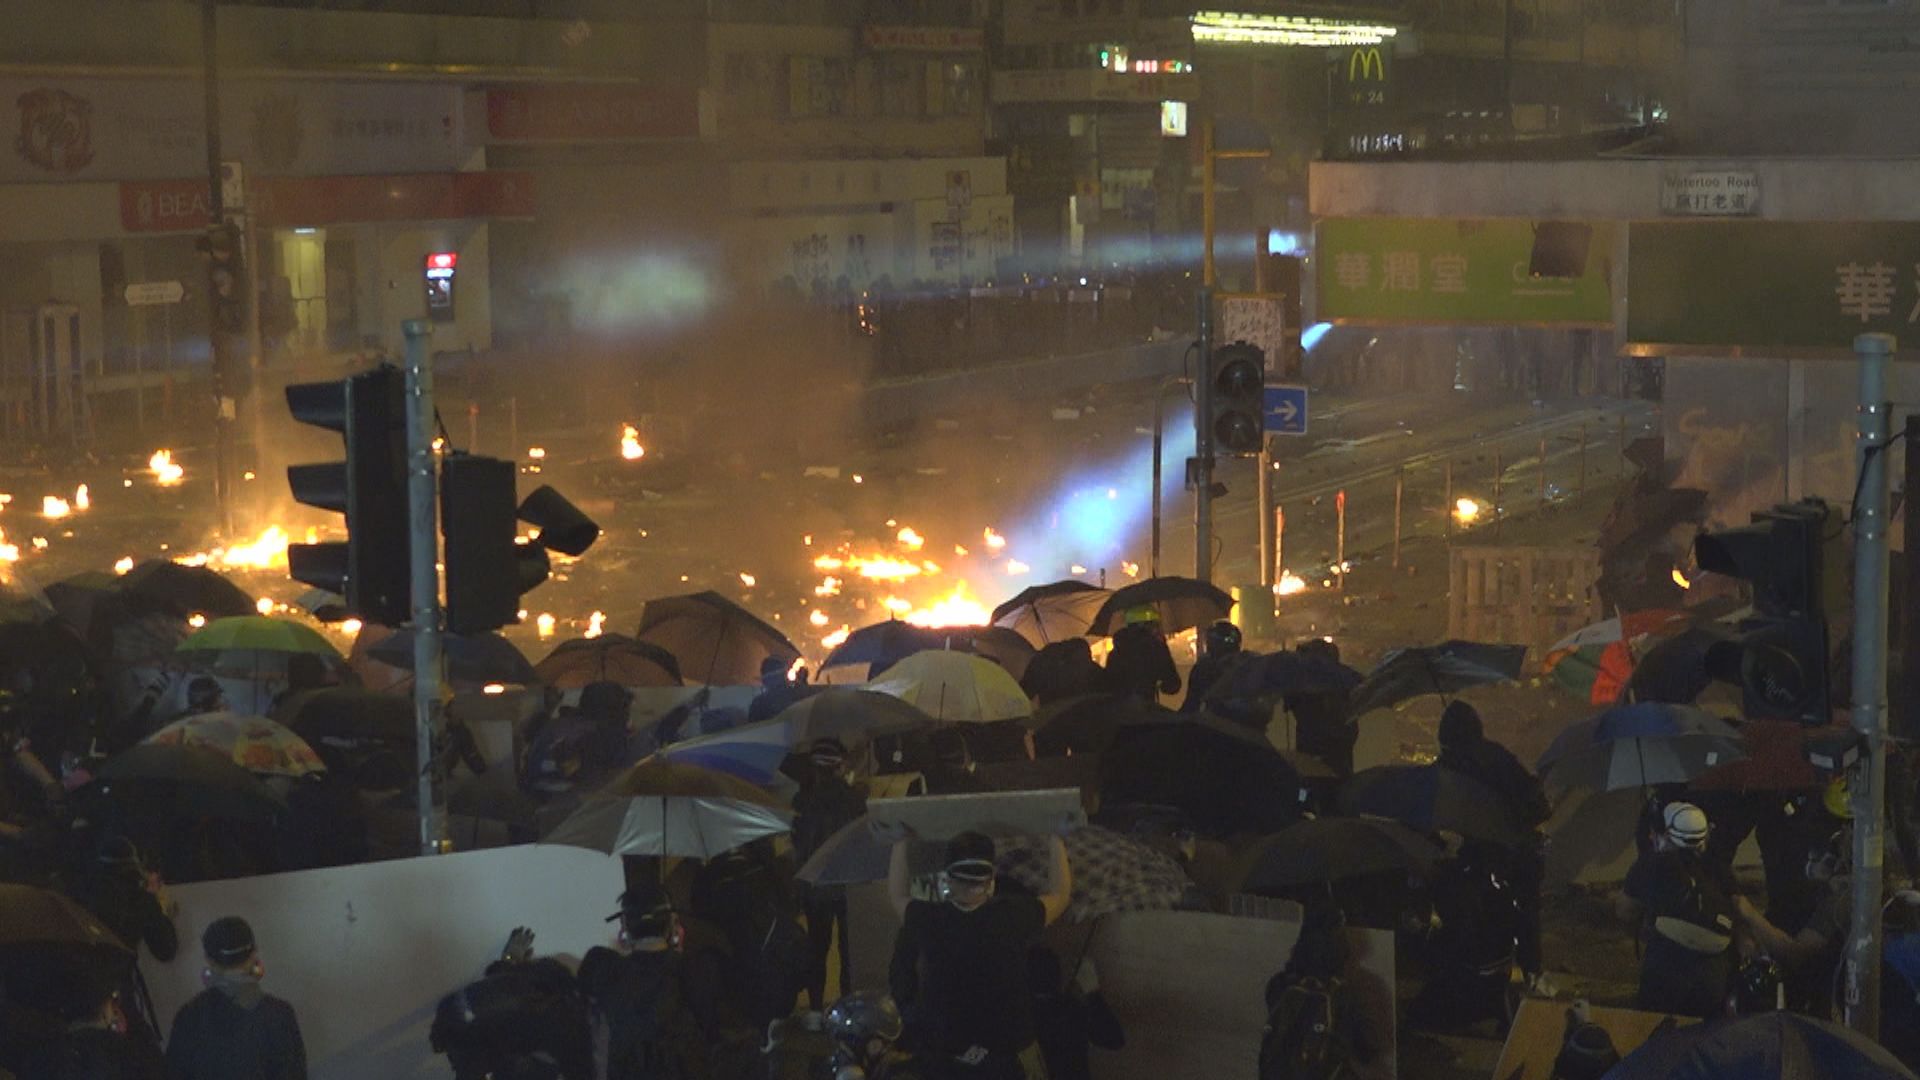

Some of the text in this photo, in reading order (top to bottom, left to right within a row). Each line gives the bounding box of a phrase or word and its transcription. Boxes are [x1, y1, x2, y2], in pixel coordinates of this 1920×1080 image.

[1368, 91, 1384, 104] 24
[1664, 175, 1760, 189] Waterloo Road
[1334, 251, 1469, 293] 華潤堂
